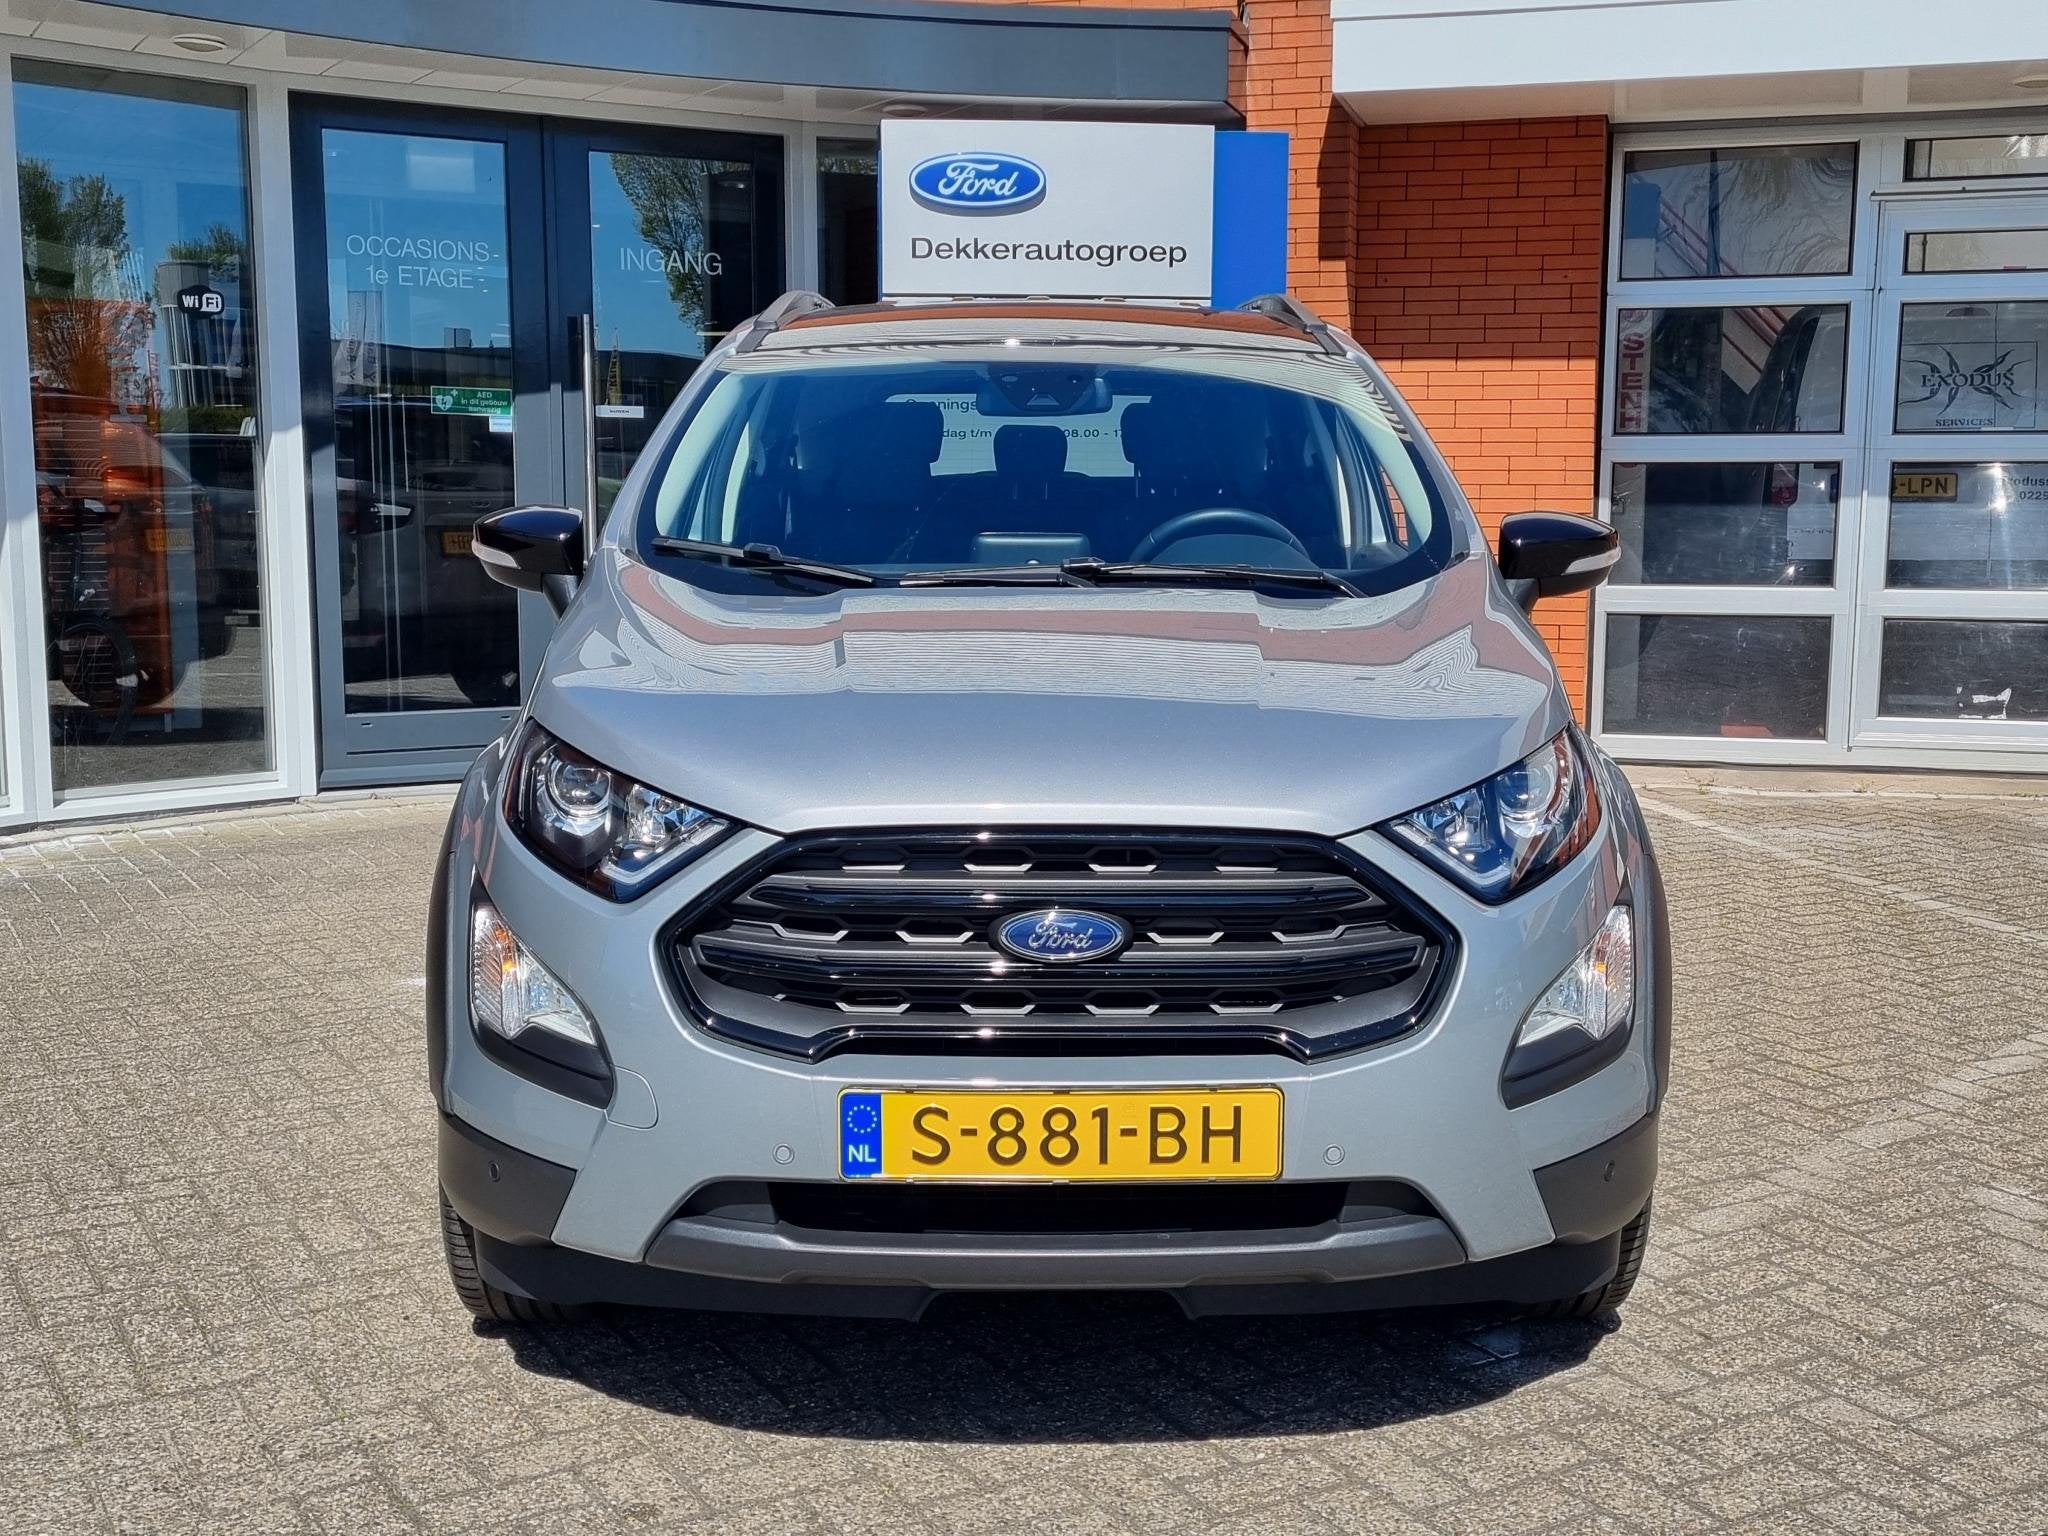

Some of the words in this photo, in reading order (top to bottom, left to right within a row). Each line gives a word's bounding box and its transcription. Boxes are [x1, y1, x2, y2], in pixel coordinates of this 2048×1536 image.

[938, 161, 1019, 197] Ford
[346, 234, 490, 262] OCCASIONS
[620, 247, 722, 275] INGANG
[911, 237, 1187, 268] Dekkerautogroep
[366, 265, 389, 285] 1e
[398, 265, 474, 289] ETAGE
[1921, 373, 2014, 388] EXODUS
[477, 391, 492, 399] AED
[970, 429, 992, 438] t/m
[1936, 418, 1994, 427] SERVICES
[1028, 919, 1094, 949] Ford
[911, 1104, 1242, 1166] S-881-BH
[848, 1144, 877, 1163] NL
